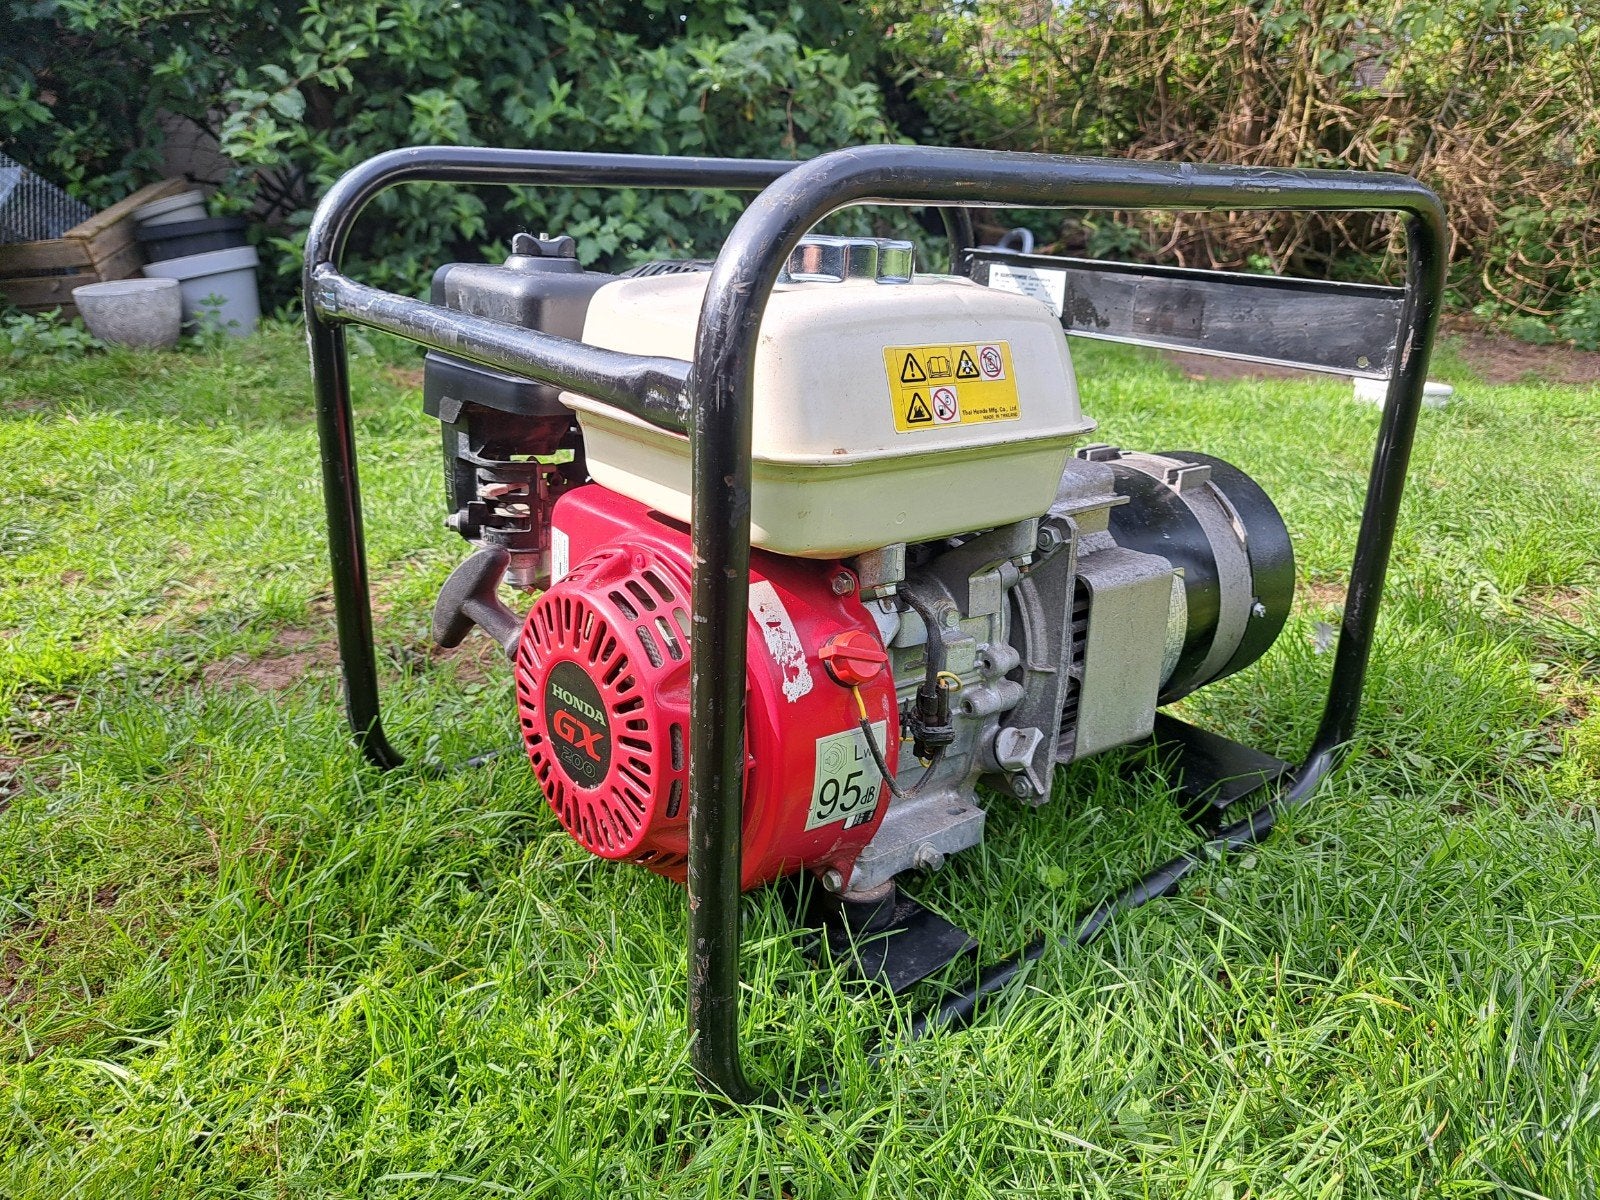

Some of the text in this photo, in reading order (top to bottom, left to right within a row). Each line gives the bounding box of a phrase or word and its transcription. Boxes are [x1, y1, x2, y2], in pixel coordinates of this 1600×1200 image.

[552, 683, 606, 727] HONDA
[553, 709, 605, 762] GX
[561, 745, 596, 778] 200
